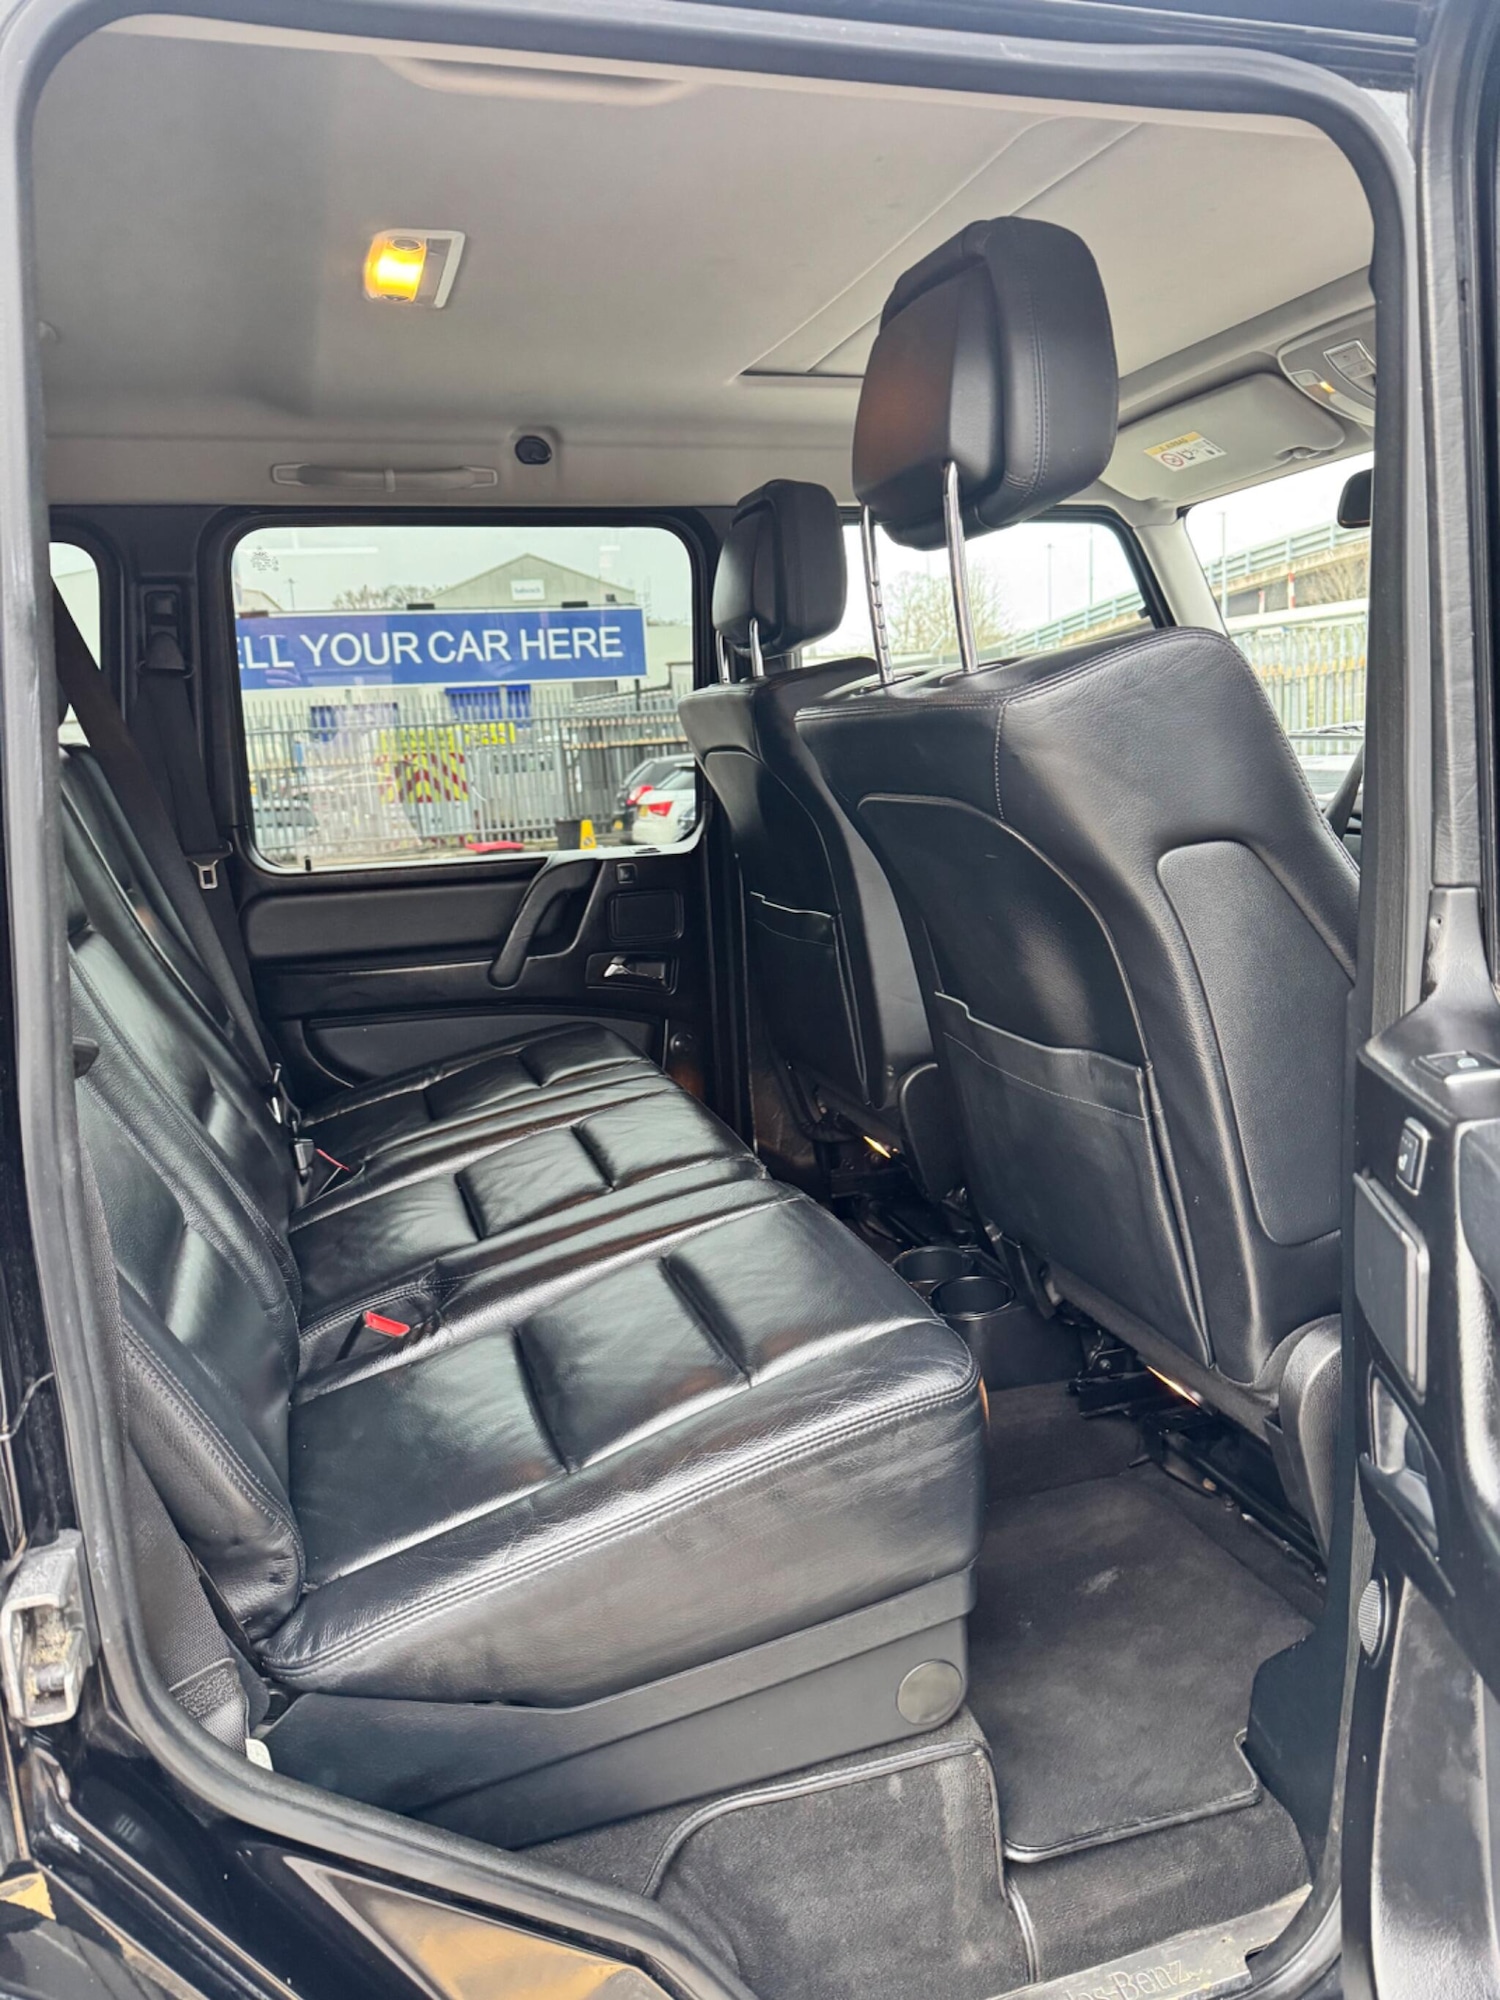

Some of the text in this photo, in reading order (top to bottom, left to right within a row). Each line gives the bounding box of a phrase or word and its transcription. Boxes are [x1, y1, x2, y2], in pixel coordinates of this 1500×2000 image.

[299, 631, 423, 667] YOUR
[427, 629, 512, 664] CAR
[519, 626, 624, 661] HERE
